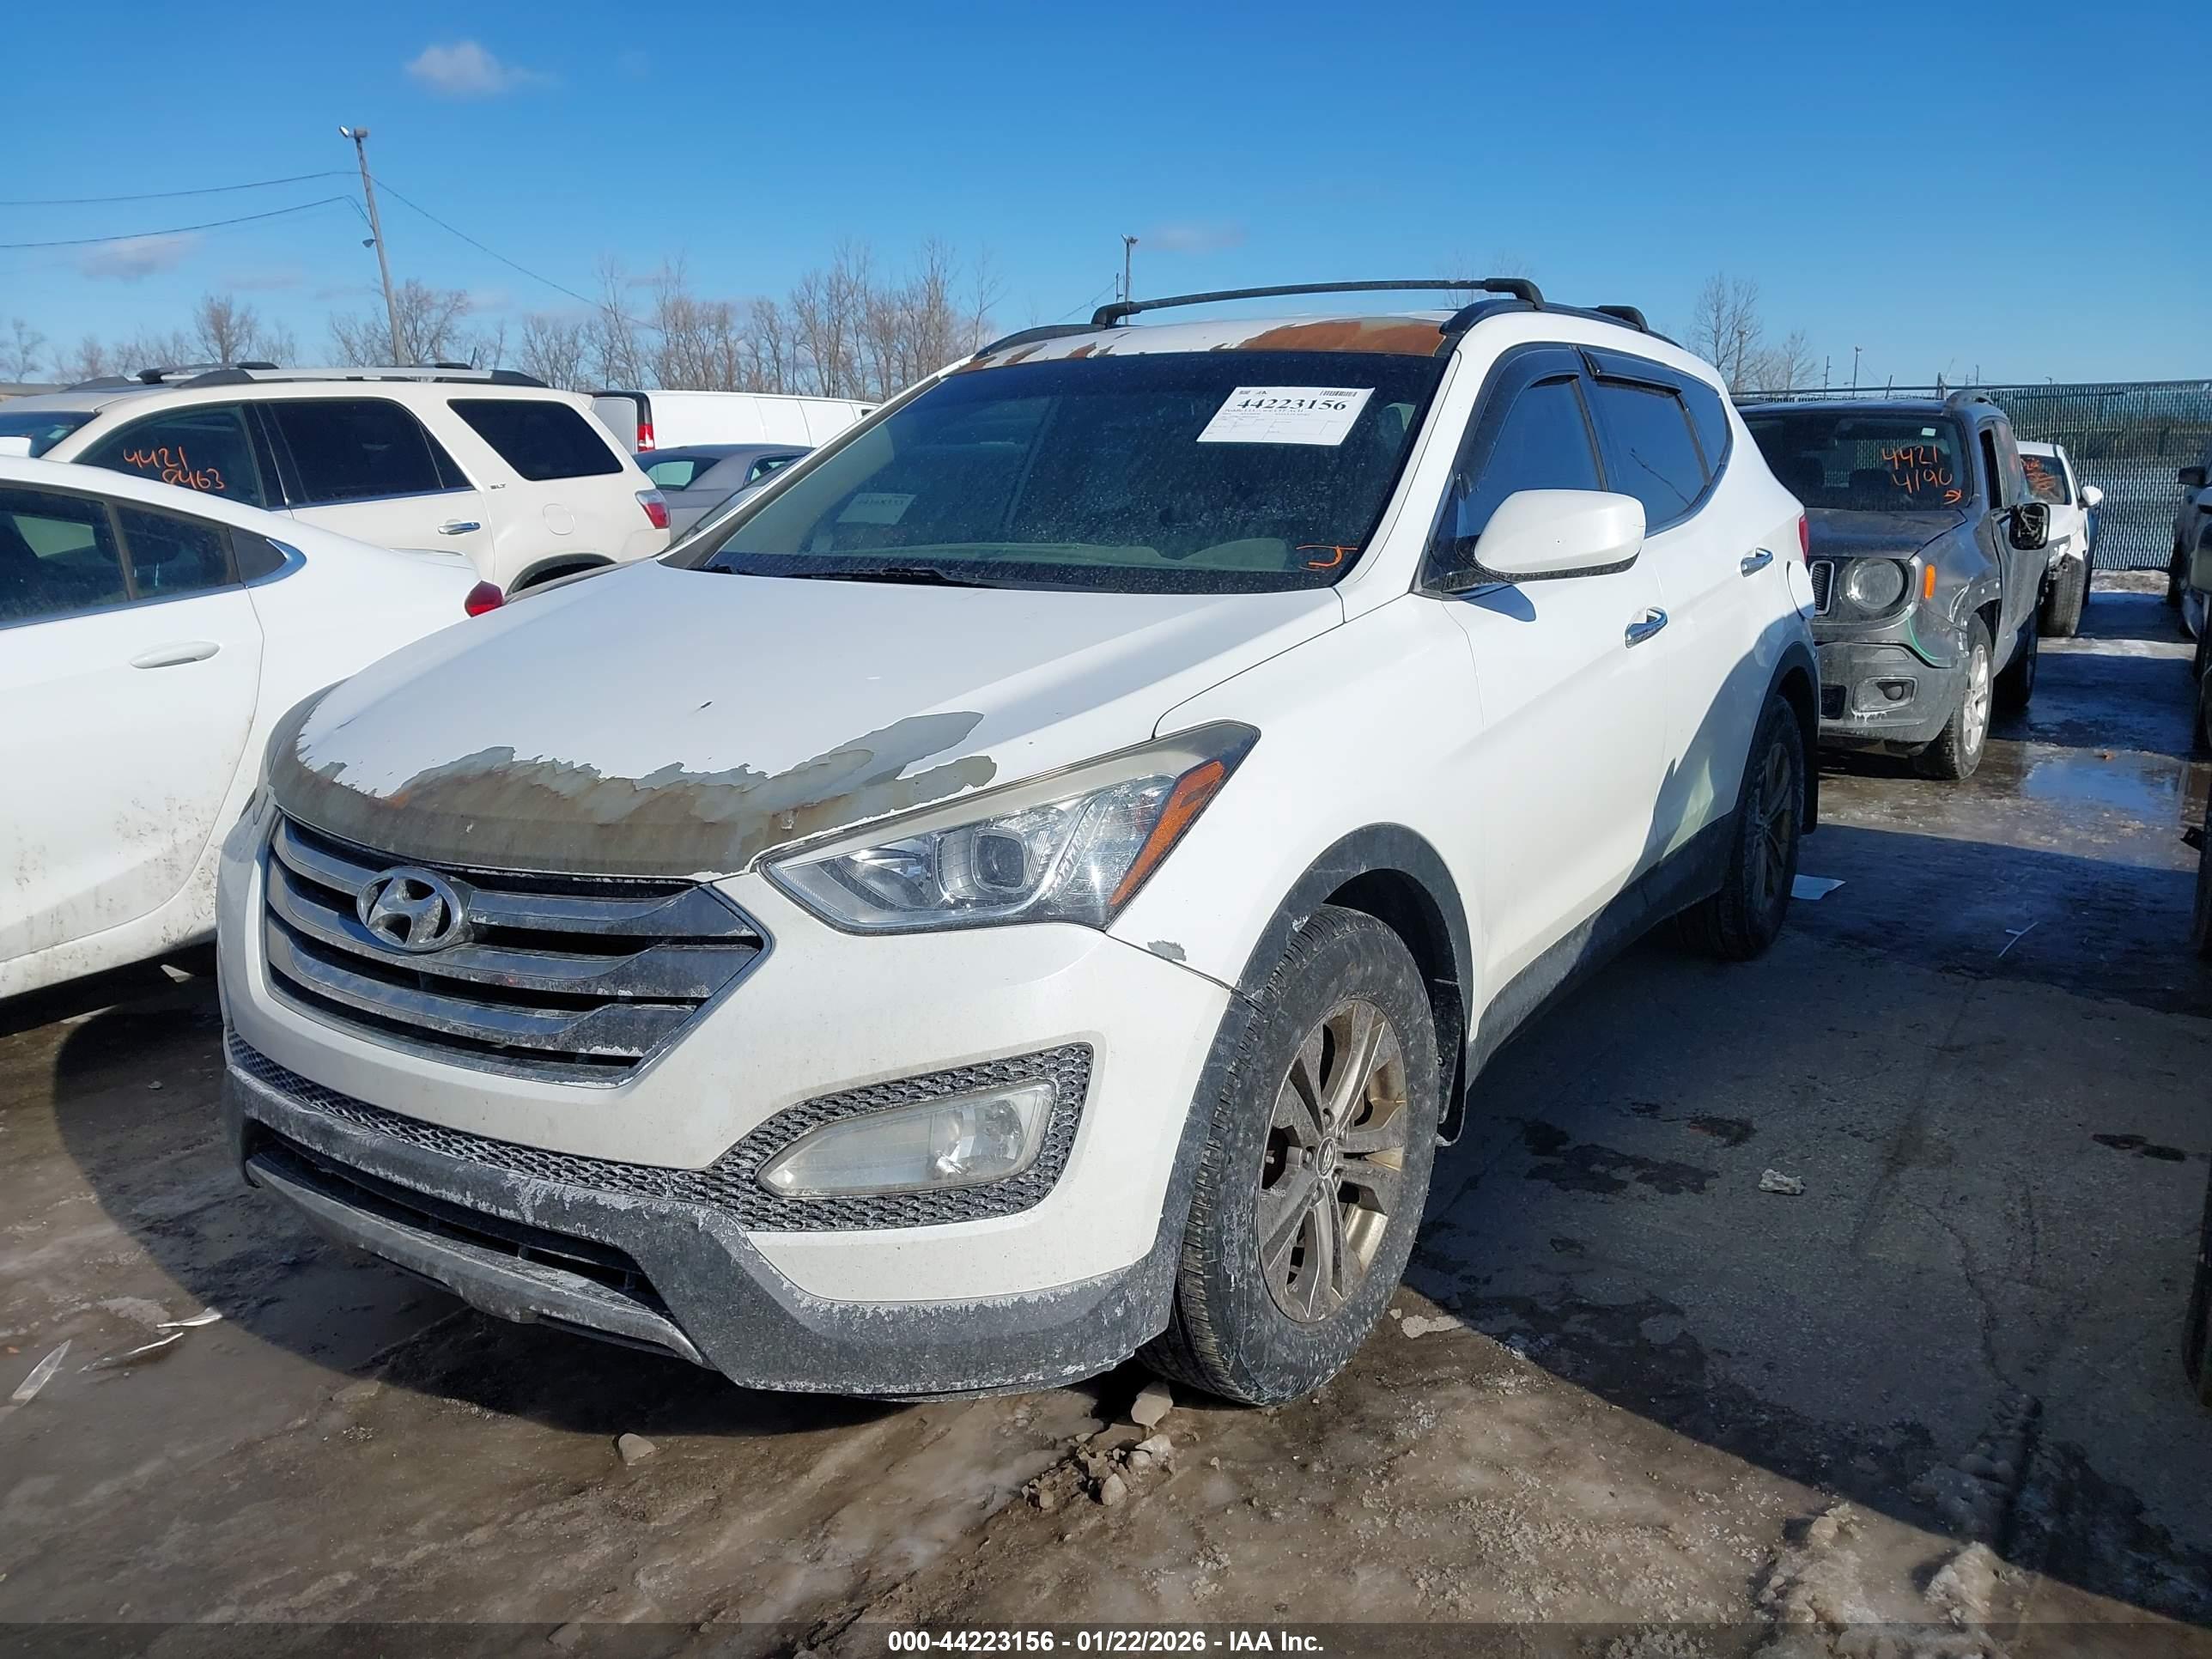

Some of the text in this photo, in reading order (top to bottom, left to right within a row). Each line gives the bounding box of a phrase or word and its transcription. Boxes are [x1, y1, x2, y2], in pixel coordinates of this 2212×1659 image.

[1237, 398, 1347, 412] 44223156
[123, 446, 188, 472] 4421
[1882, 443, 1938, 470] 4421
